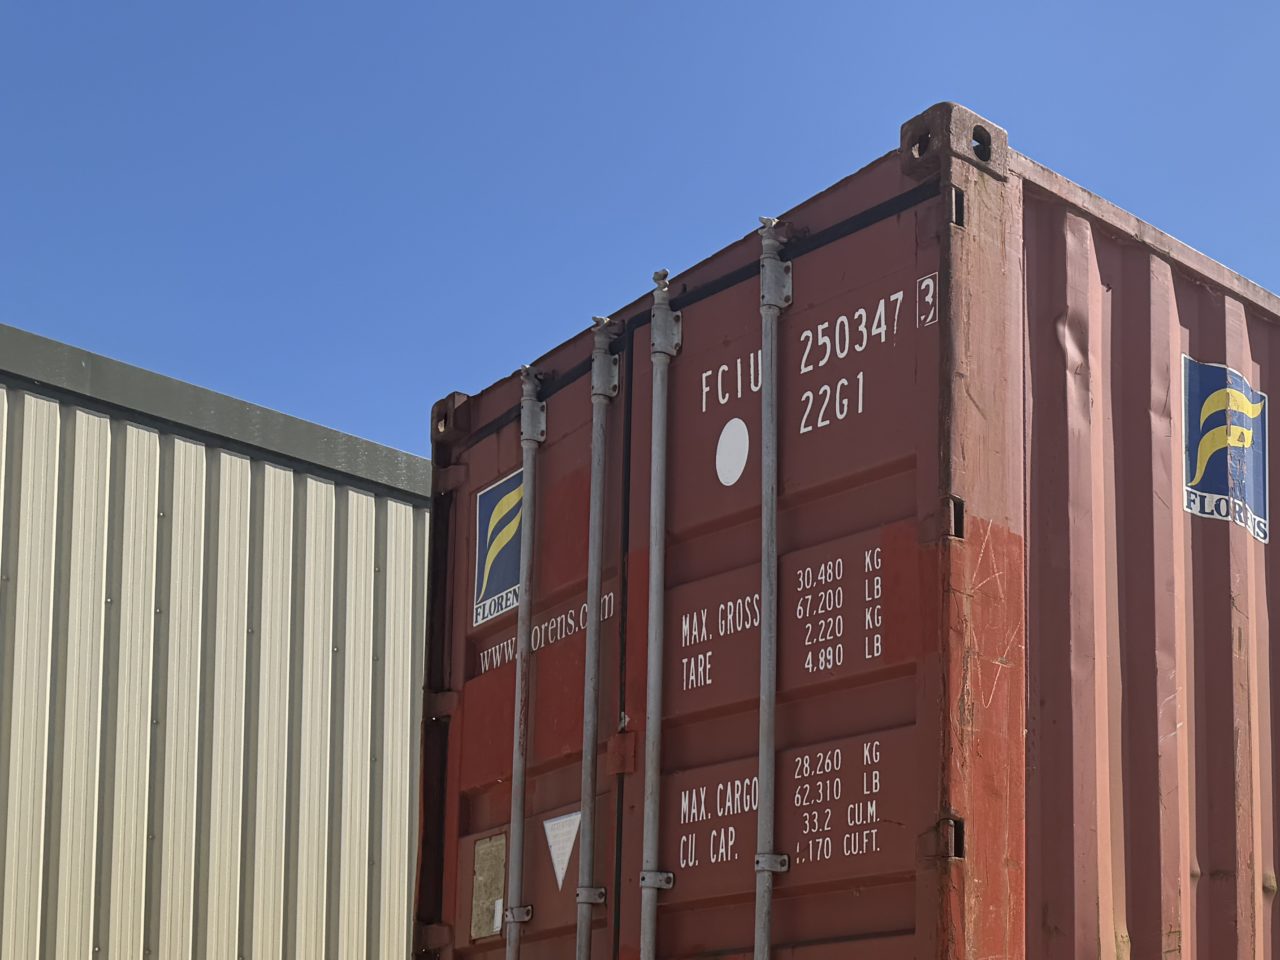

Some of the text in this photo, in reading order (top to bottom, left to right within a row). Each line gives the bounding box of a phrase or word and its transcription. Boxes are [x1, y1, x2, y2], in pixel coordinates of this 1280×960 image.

[702, 349, 762, 413] FCIU
[800, 291, 904, 375] 250347
[800, 371, 864, 434] 22G1
[1185, 490, 1268, 540] FLORNS
[474, 586, 520, 624] FLOREN
[682, 547, 881, 648] MAX. GROSS 30,480 KG
[796, 576, 881, 619] 67,200 LB
[480, 591, 614, 674] www.orens.cm
[682, 605, 881, 691] TARE 2,220 KG
[804, 634, 881, 673] 4,890 LB
[680, 741, 880, 824] MAX. CARGO 28,260 KG
[794, 770, 880, 807] 62,310 LB
[679, 799, 880, 868] CU. CAP. 33.2 CU.M.
[843, 829, 880, 856] CU.FT.
